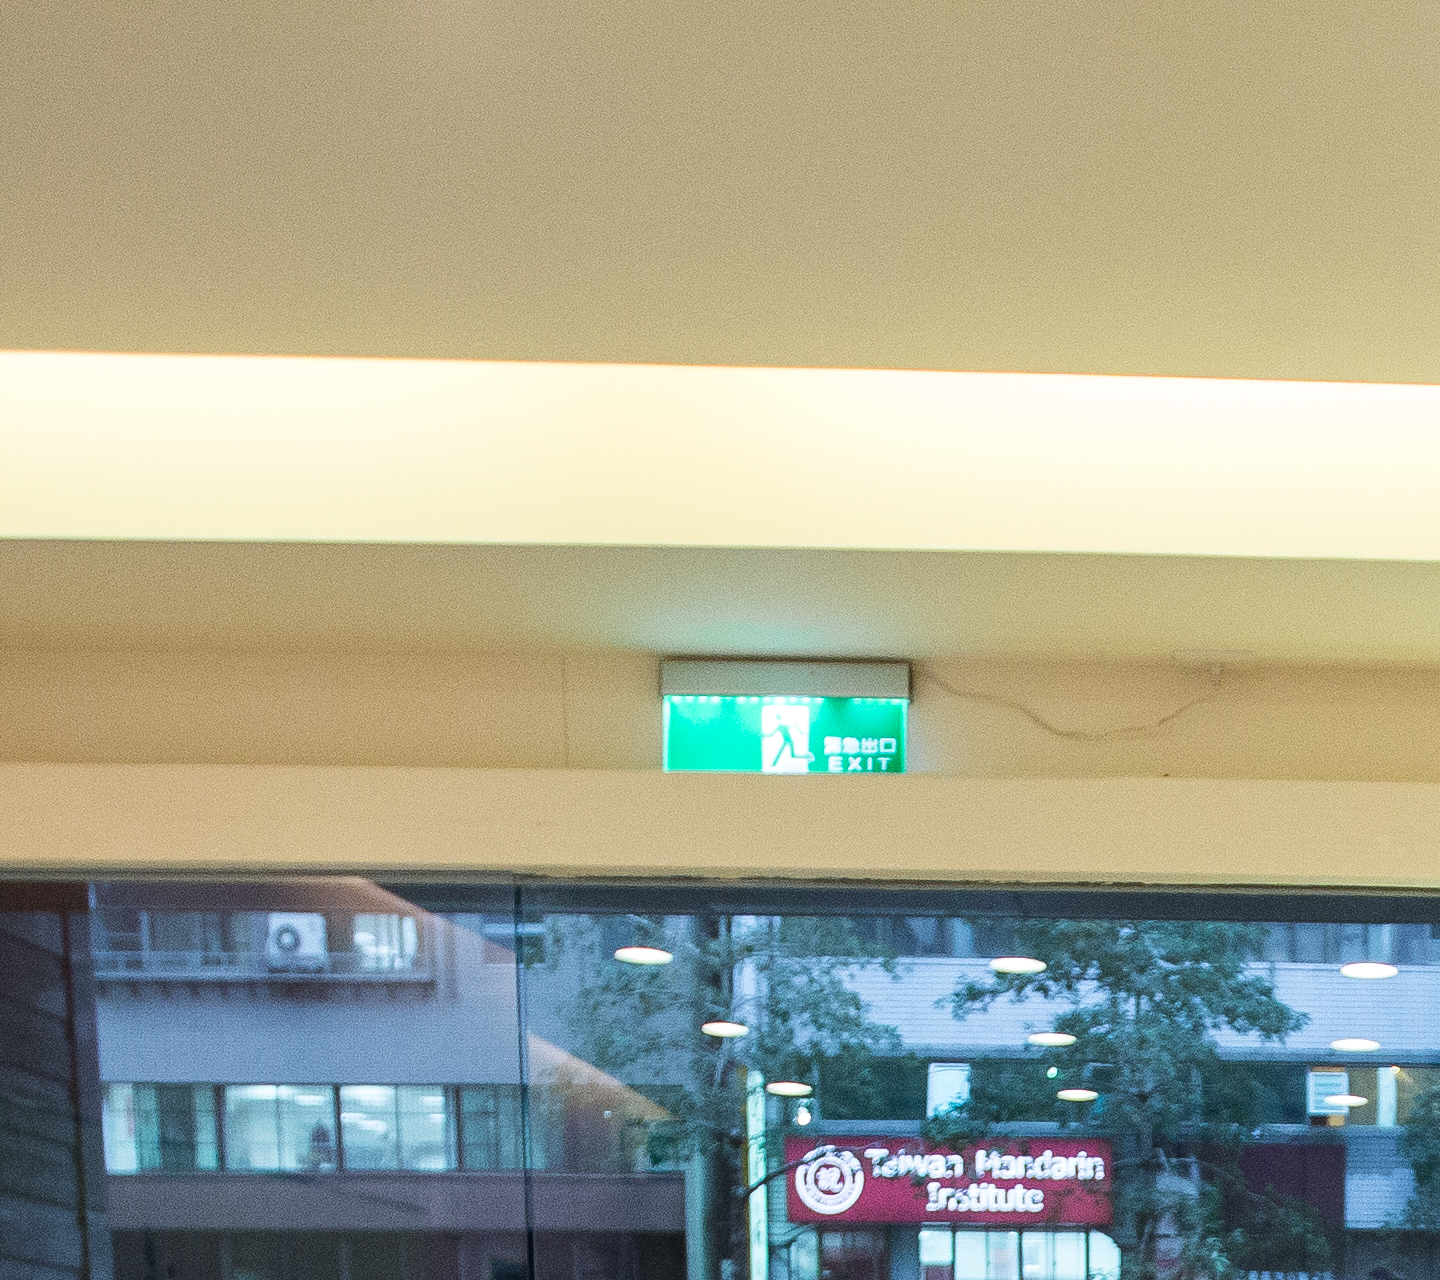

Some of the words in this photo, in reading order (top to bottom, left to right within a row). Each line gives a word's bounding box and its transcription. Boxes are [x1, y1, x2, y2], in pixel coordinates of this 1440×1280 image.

[827, 756, 891, 773] EXIT
[863, 1148, 964, 1179] Taiwan
[975, 1149, 1106, 1181] Mandarin
[925, 1181, 1045, 1213] Institute
